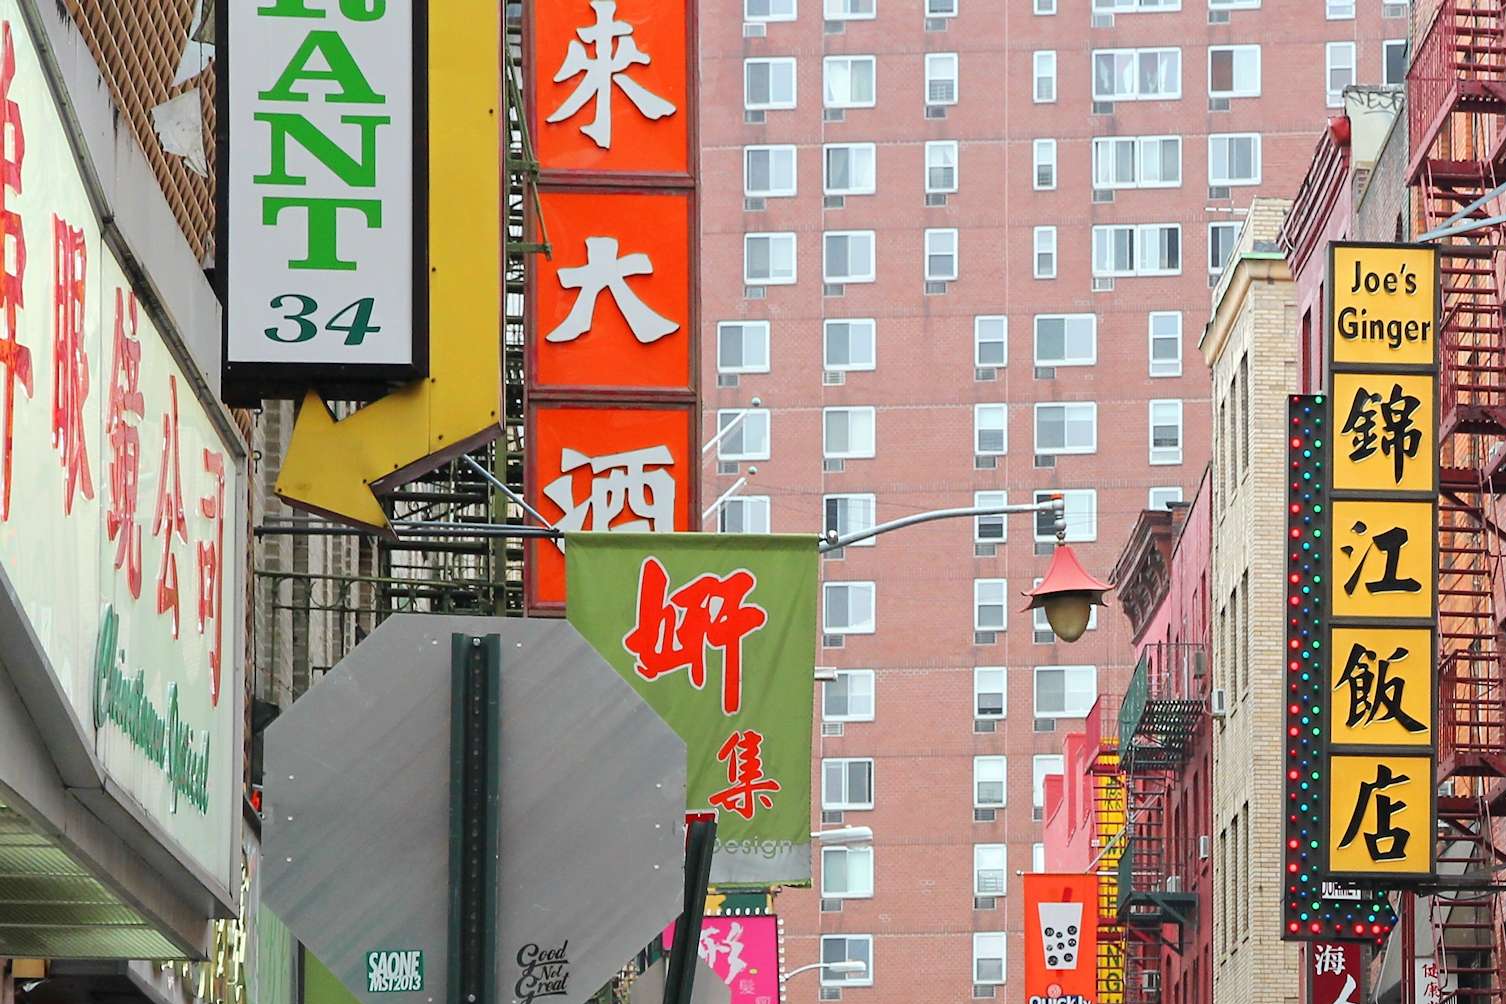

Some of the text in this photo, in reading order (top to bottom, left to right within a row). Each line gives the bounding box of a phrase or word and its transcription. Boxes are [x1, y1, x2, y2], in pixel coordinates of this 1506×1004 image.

[253, 0, 390, 272] ANT
[1351, 260, 1418, 296] Joe's
[264, 293, 381, 346] 34
[1337, 307, 1431, 350] Ginger
[1334, 383, 1429, 863] 錦江飯店
[368, 951, 420, 979] SAONE
[516, 939, 569, 976] Good
[539, 966, 562, 981] Not
